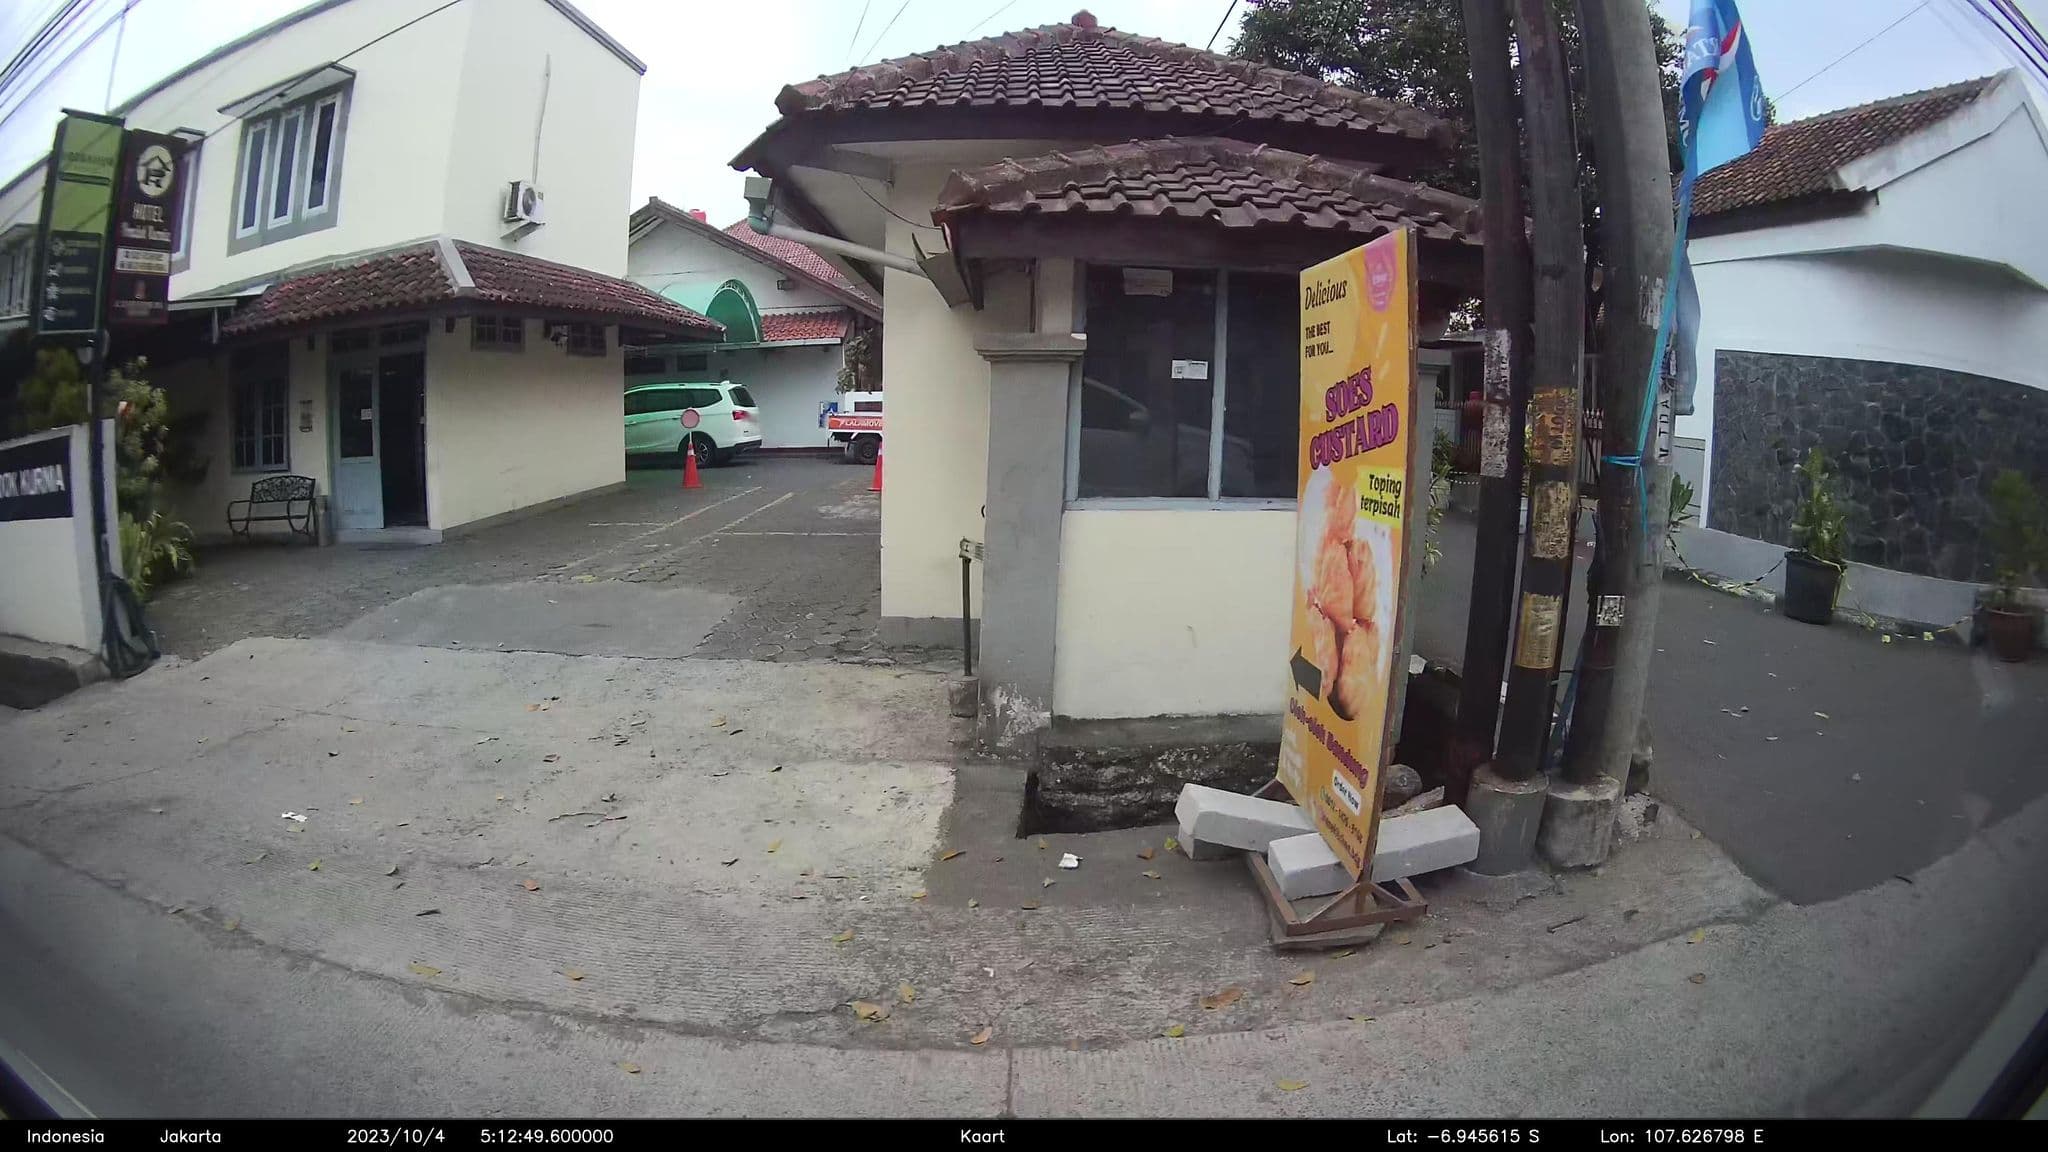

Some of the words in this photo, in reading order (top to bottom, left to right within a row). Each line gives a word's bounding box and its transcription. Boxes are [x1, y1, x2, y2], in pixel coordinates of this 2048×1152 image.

[1305, 279, 1347, 310] Delicious
[1305, 324, 1316, 339] THE
[1316, 321, 1331, 337] BEST
[1305, 345, 1316, 359] FOR
[1325, 364, 1373, 422] SOES
[1310, 403, 1399, 470] CUSTARD
[1369, 473, 1402, 499] Toping
[1361, 494, 1401, 519] terpisah
[1326, 731, 1369, 789] Bandung
